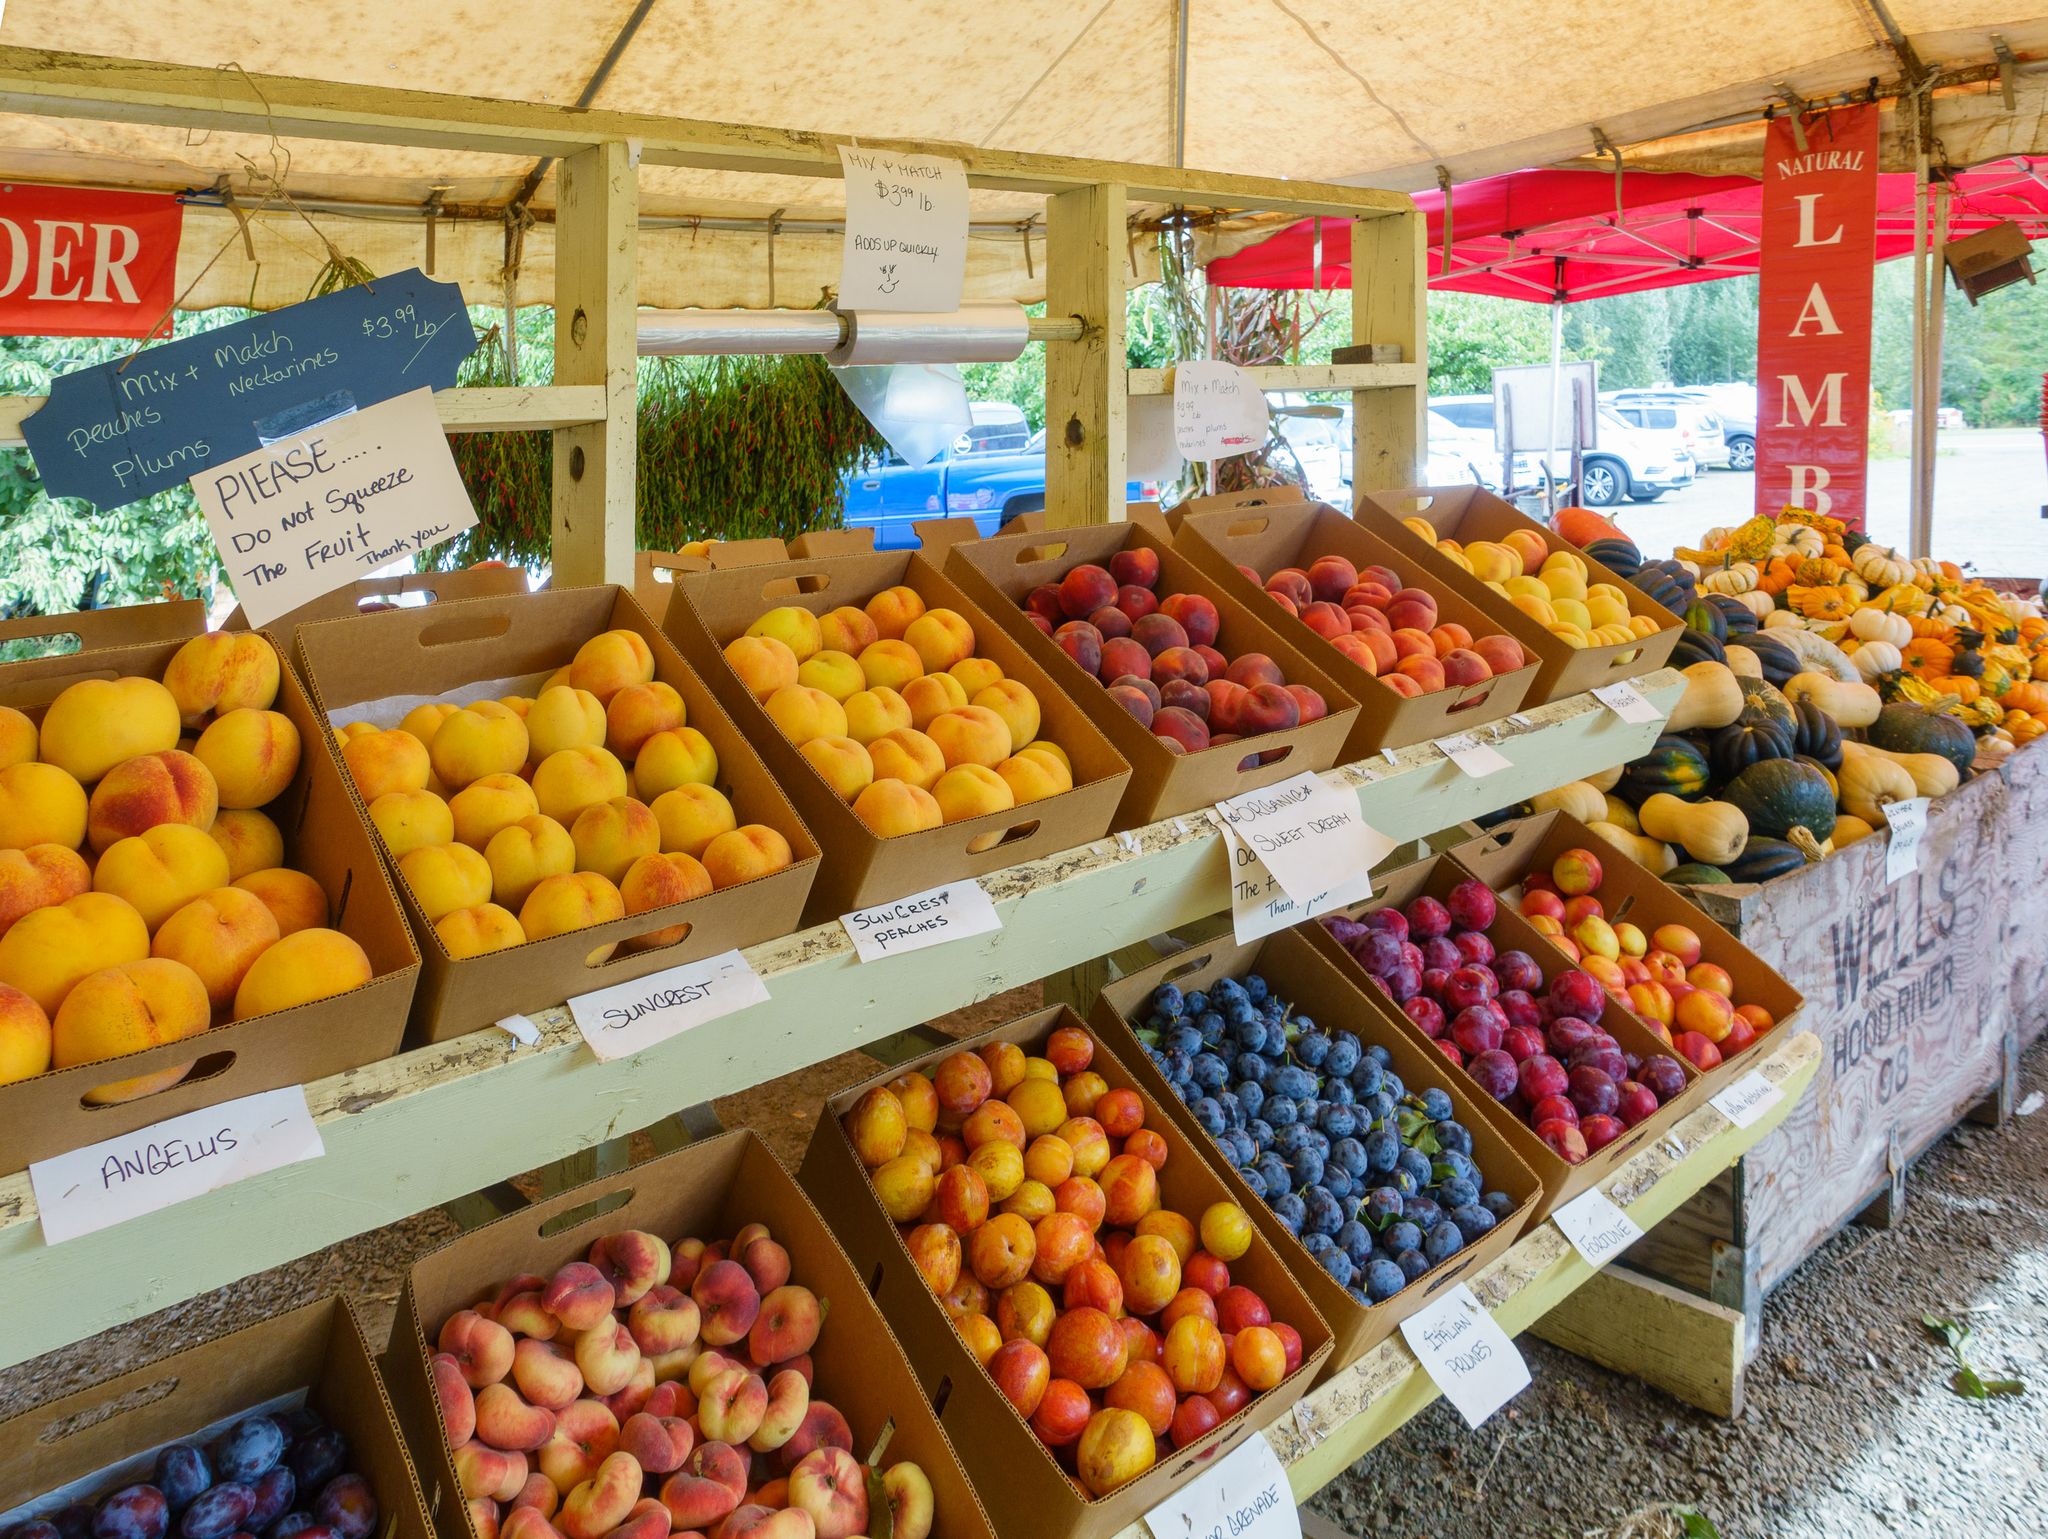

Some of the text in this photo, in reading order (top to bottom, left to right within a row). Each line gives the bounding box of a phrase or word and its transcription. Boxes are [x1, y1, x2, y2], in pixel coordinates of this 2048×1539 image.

[848, 152, 876, 171] MIX
[898, 163, 943, 181] MATCH
[1777, 150, 1865, 180] NATURAL
[854, 234, 938, 263] ADDS UP QUICKLY
[120, 330, 294, 400] Mix + Match
[228, 346, 340, 397] Nectarines
[1775, 192, 1850, 517] LAMB
[111, 439, 212, 488] Plums
[231, 467, 414, 554] Do Not Squeeze
[355, 538, 411, 566] Thank
[242, 561, 288, 587] The
[1253, 811, 1352, 853] SWEET DREAM
[852, 890, 950, 931] SUNCREST
[1233, 880, 1261, 901] The
[874, 915, 949, 950] PEACHES
[1832, 859, 1956, 1012] WELLS
[602, 980, 713, 1029] SUNCREST
[1834, 954, 1954, 1080] HOOD RIVER
[100, 1128, 238, 1189] ANGELUS
[1578, 1218, 1632, 1257] FORTUNE
[1444, 1339, 1492, 1378] PRUNES
[1226, 1483, 1280, 1537] GRENADE
